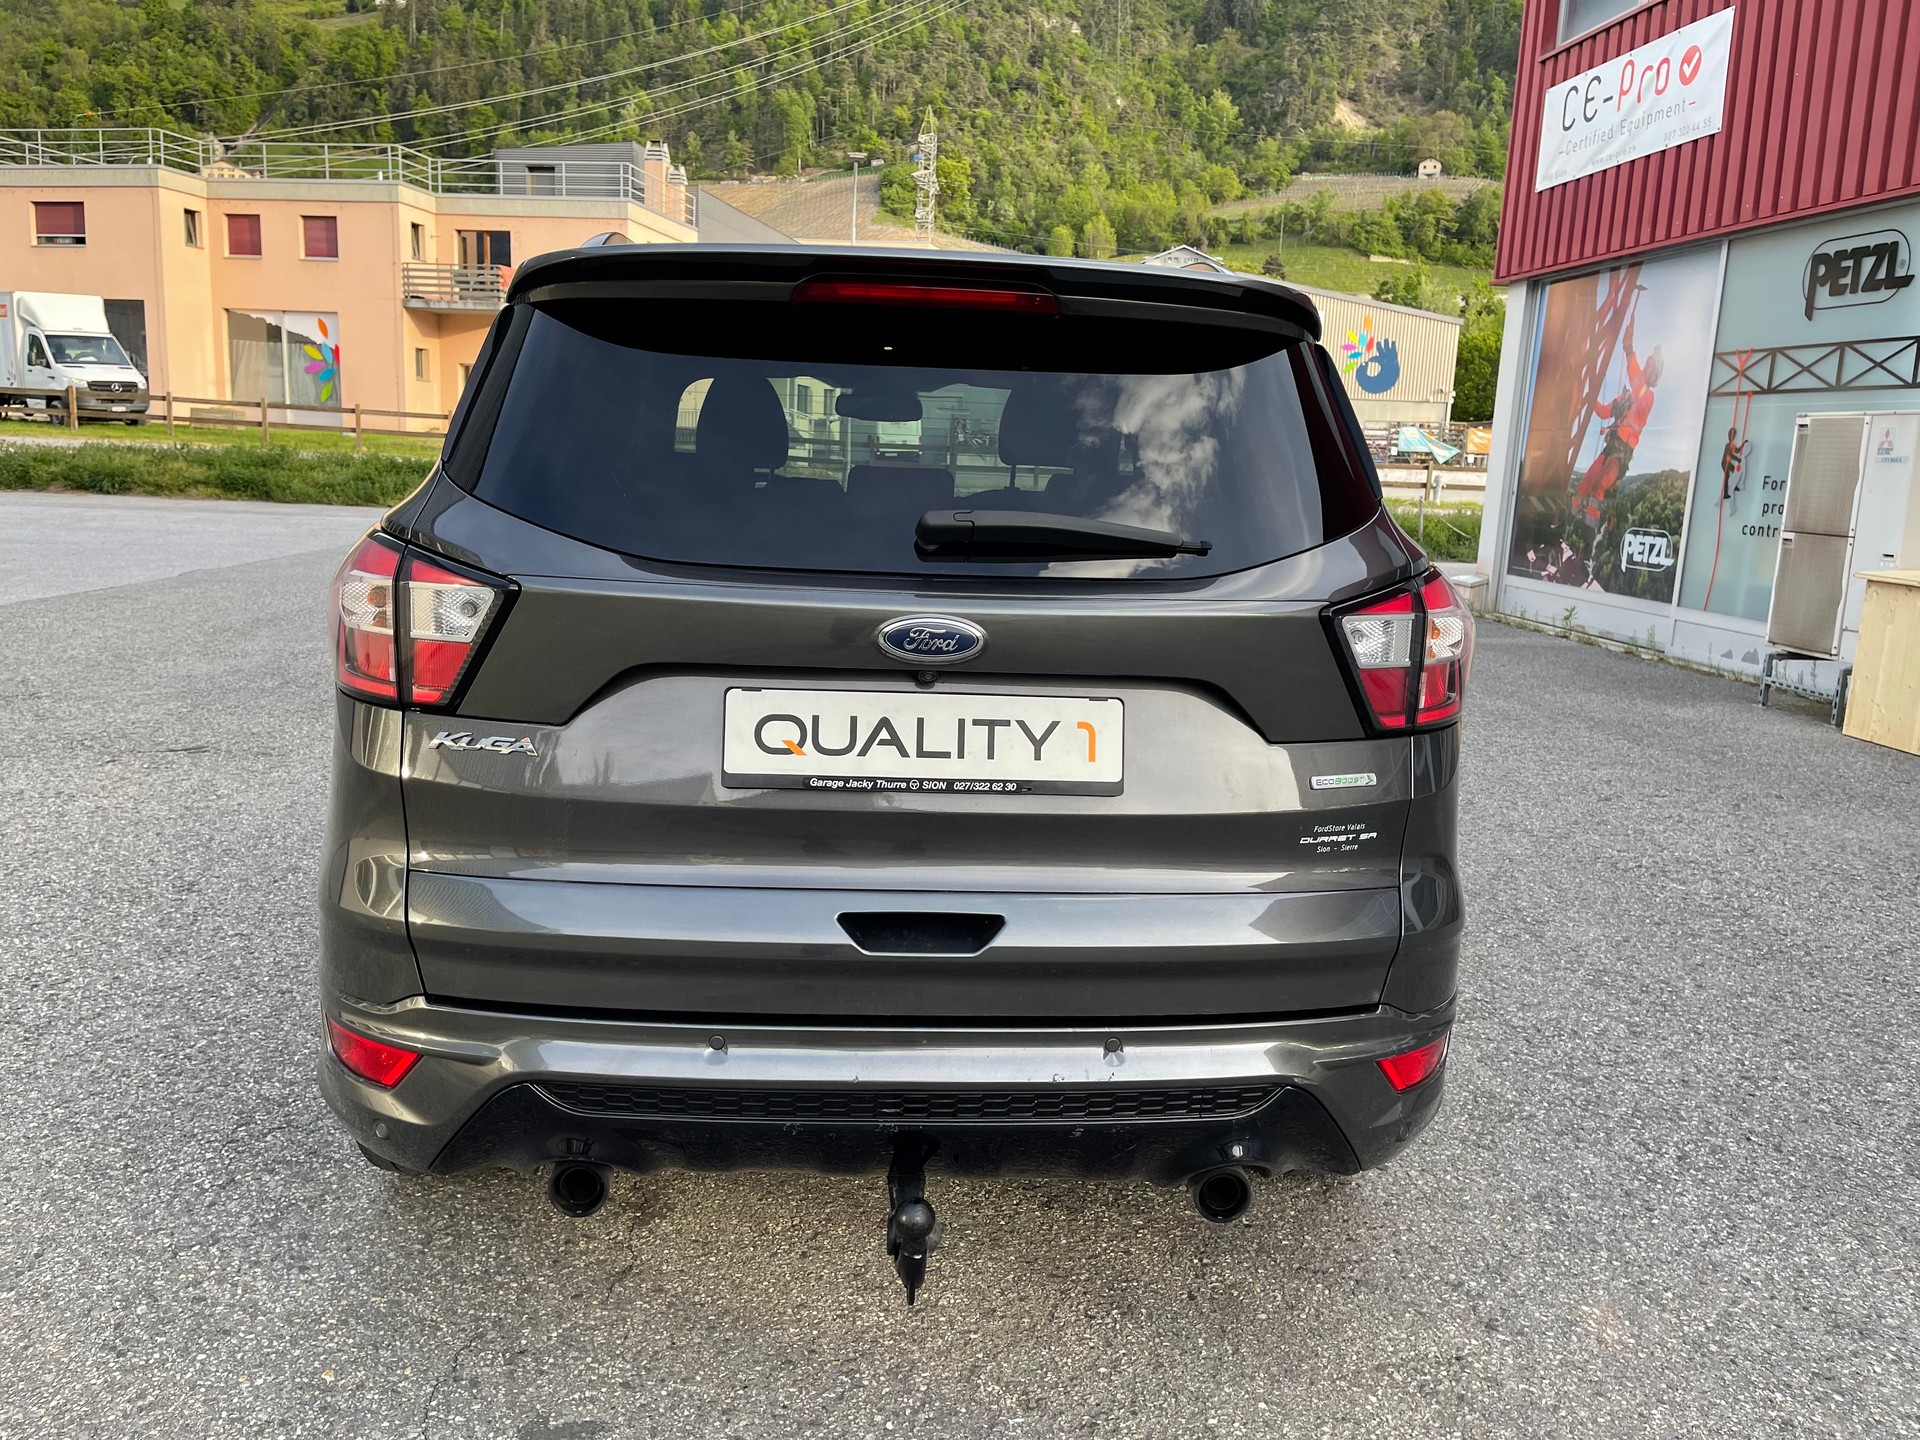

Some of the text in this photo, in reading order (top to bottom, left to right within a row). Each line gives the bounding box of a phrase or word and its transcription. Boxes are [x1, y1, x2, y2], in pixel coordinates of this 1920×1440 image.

[1804, 240, 1915, 321] PETZL
[1762, 475, 1786, 491] For
[1741, 524, 1780, 538] contr
[1621, 533, 1675, 573] PETZL
[902, 627, 960, 651] Ford
[428, 731, 538, 757] KUGA
[754, 713, 1097, 763] QUALITY 1
[809, 777, 1017, 791] Garage Jacky Thurre SION 027/322 62 30
[1313, 822, 1366, 833] FordStore Valais
[1358, 832, 1377, 840] SA
[1316, 845, 1331, 853] Sion
[1341, 844, 1359, 852] Sierre
